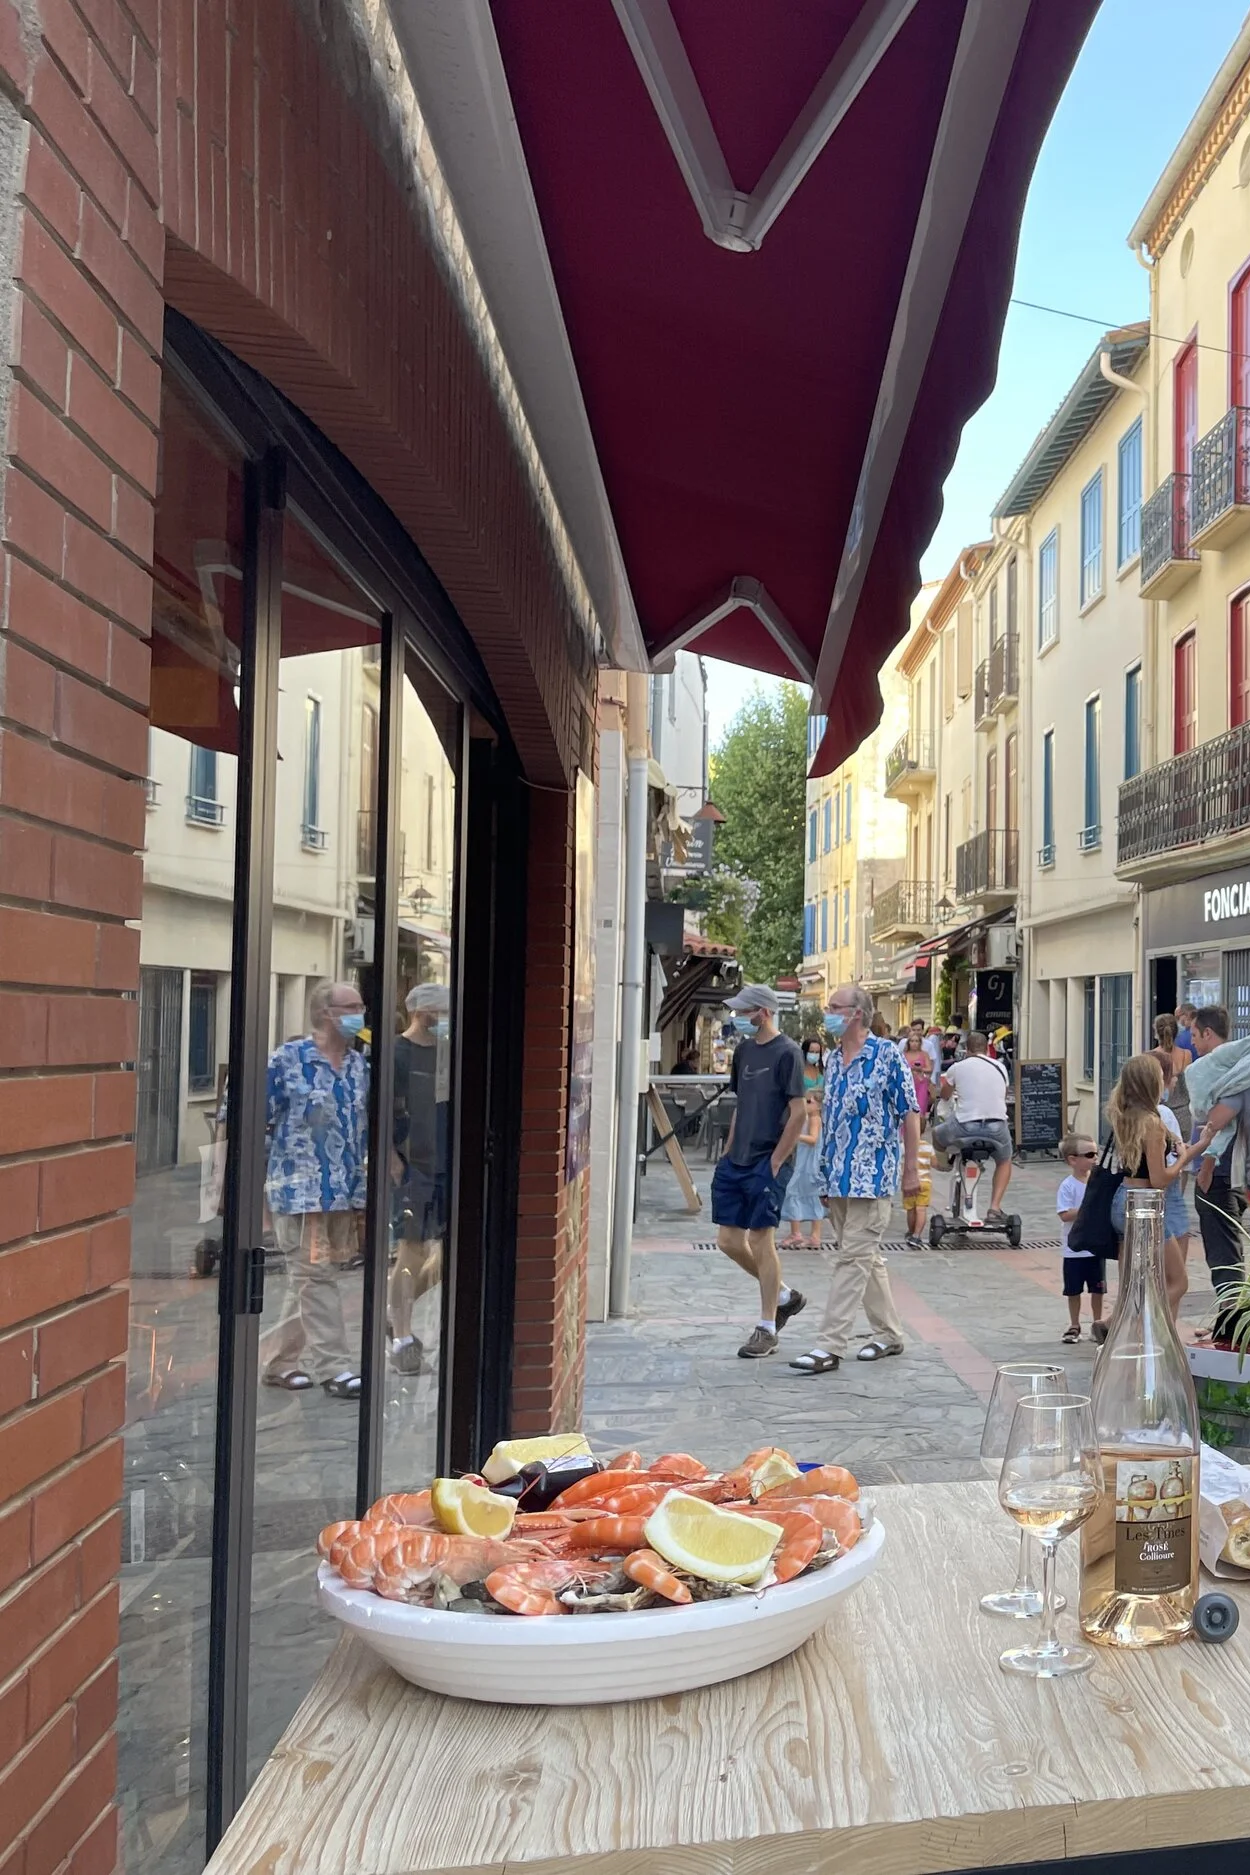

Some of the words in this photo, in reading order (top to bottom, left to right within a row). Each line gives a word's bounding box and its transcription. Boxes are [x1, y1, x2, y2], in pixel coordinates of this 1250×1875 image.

[1126, 1527, 1149, 1541] Les
[1154, 1526, 1186, 1540] Tines
[1139, 1551, 1175, 1561] Collioure
